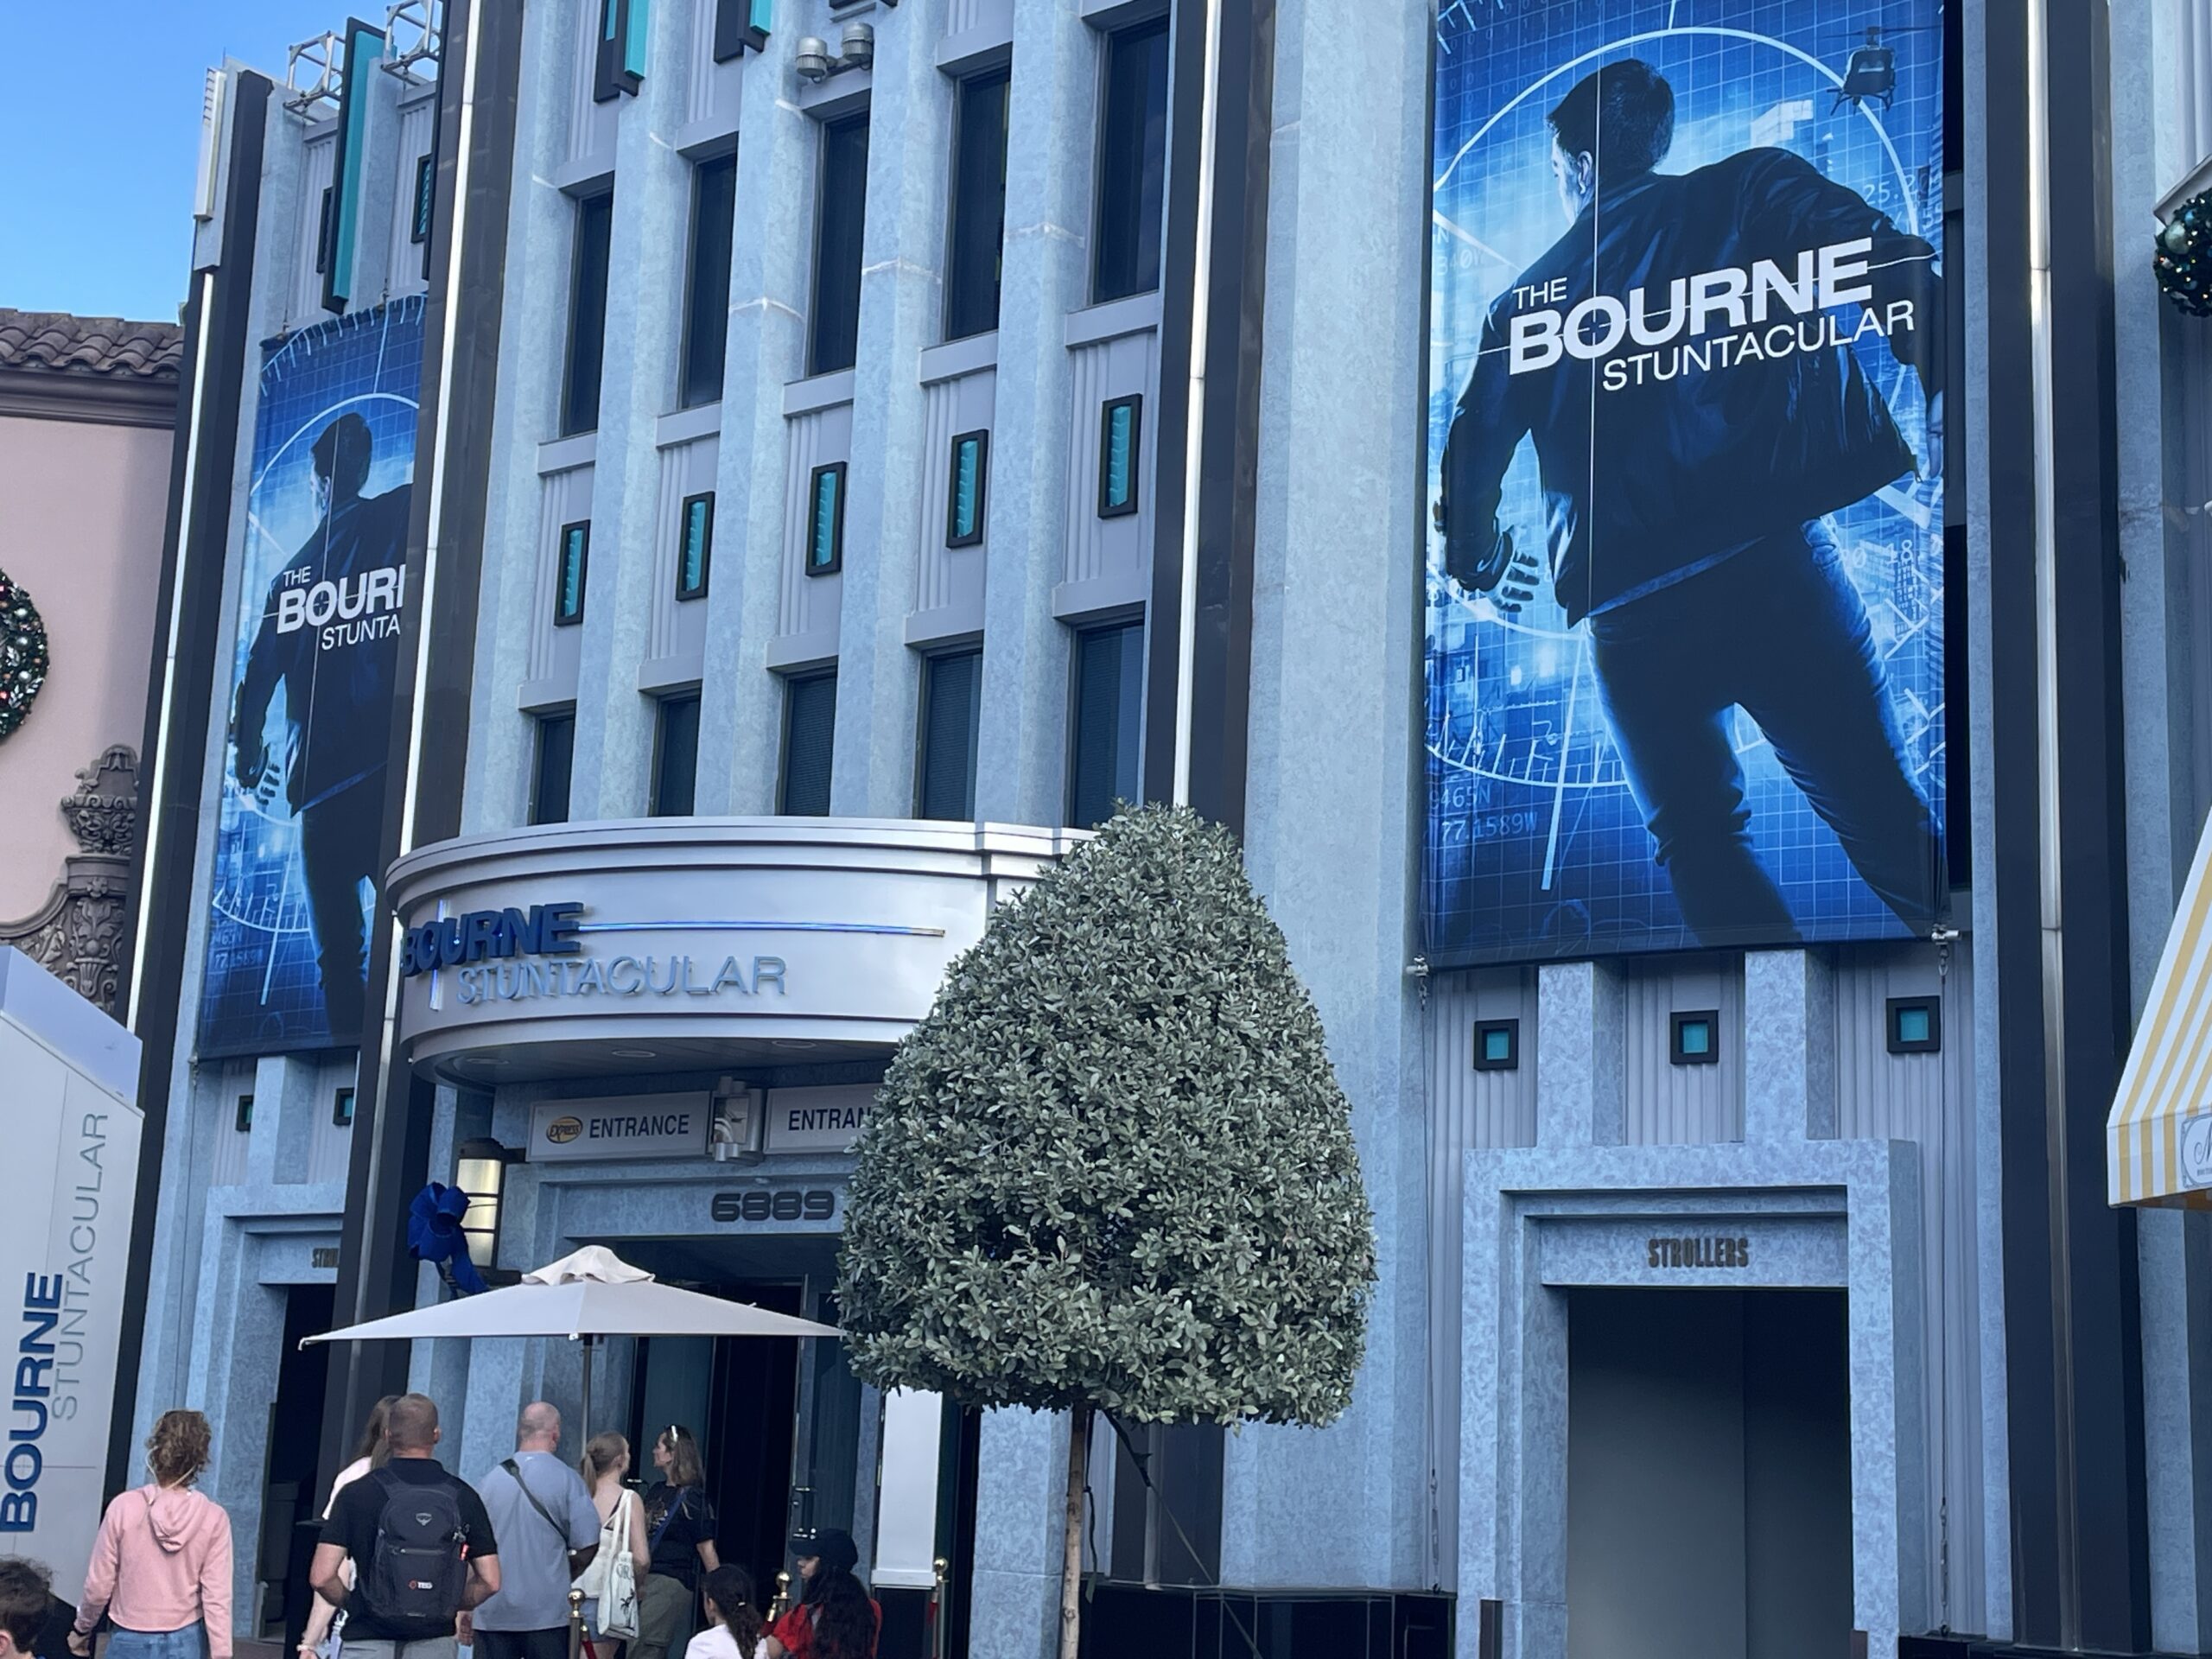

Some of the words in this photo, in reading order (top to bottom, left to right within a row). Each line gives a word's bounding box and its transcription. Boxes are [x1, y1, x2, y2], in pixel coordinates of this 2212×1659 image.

[1509, 237, 1872, 375] BOURNE
[1513, 277, 1567, 309] THE
[1602, 301, 1915, 391] STUNTACULAR
[283, 566, 311, 588] THE
[321, 614, 401, 651] STUNTA
[403, 902, 584, 977] BOURNE
[456, 955, 787, 1005] STUNTACULAR
[589, 1114, 690, 1139] ENTRANCE
[711, 1190, 835, 1222] 6889
[52, 1112, 108, 1421] STUNTACULAR
[1648, 1237, 1749, 1268] STROLLERS
[0, 1272, 63, 1533] BOURNE
